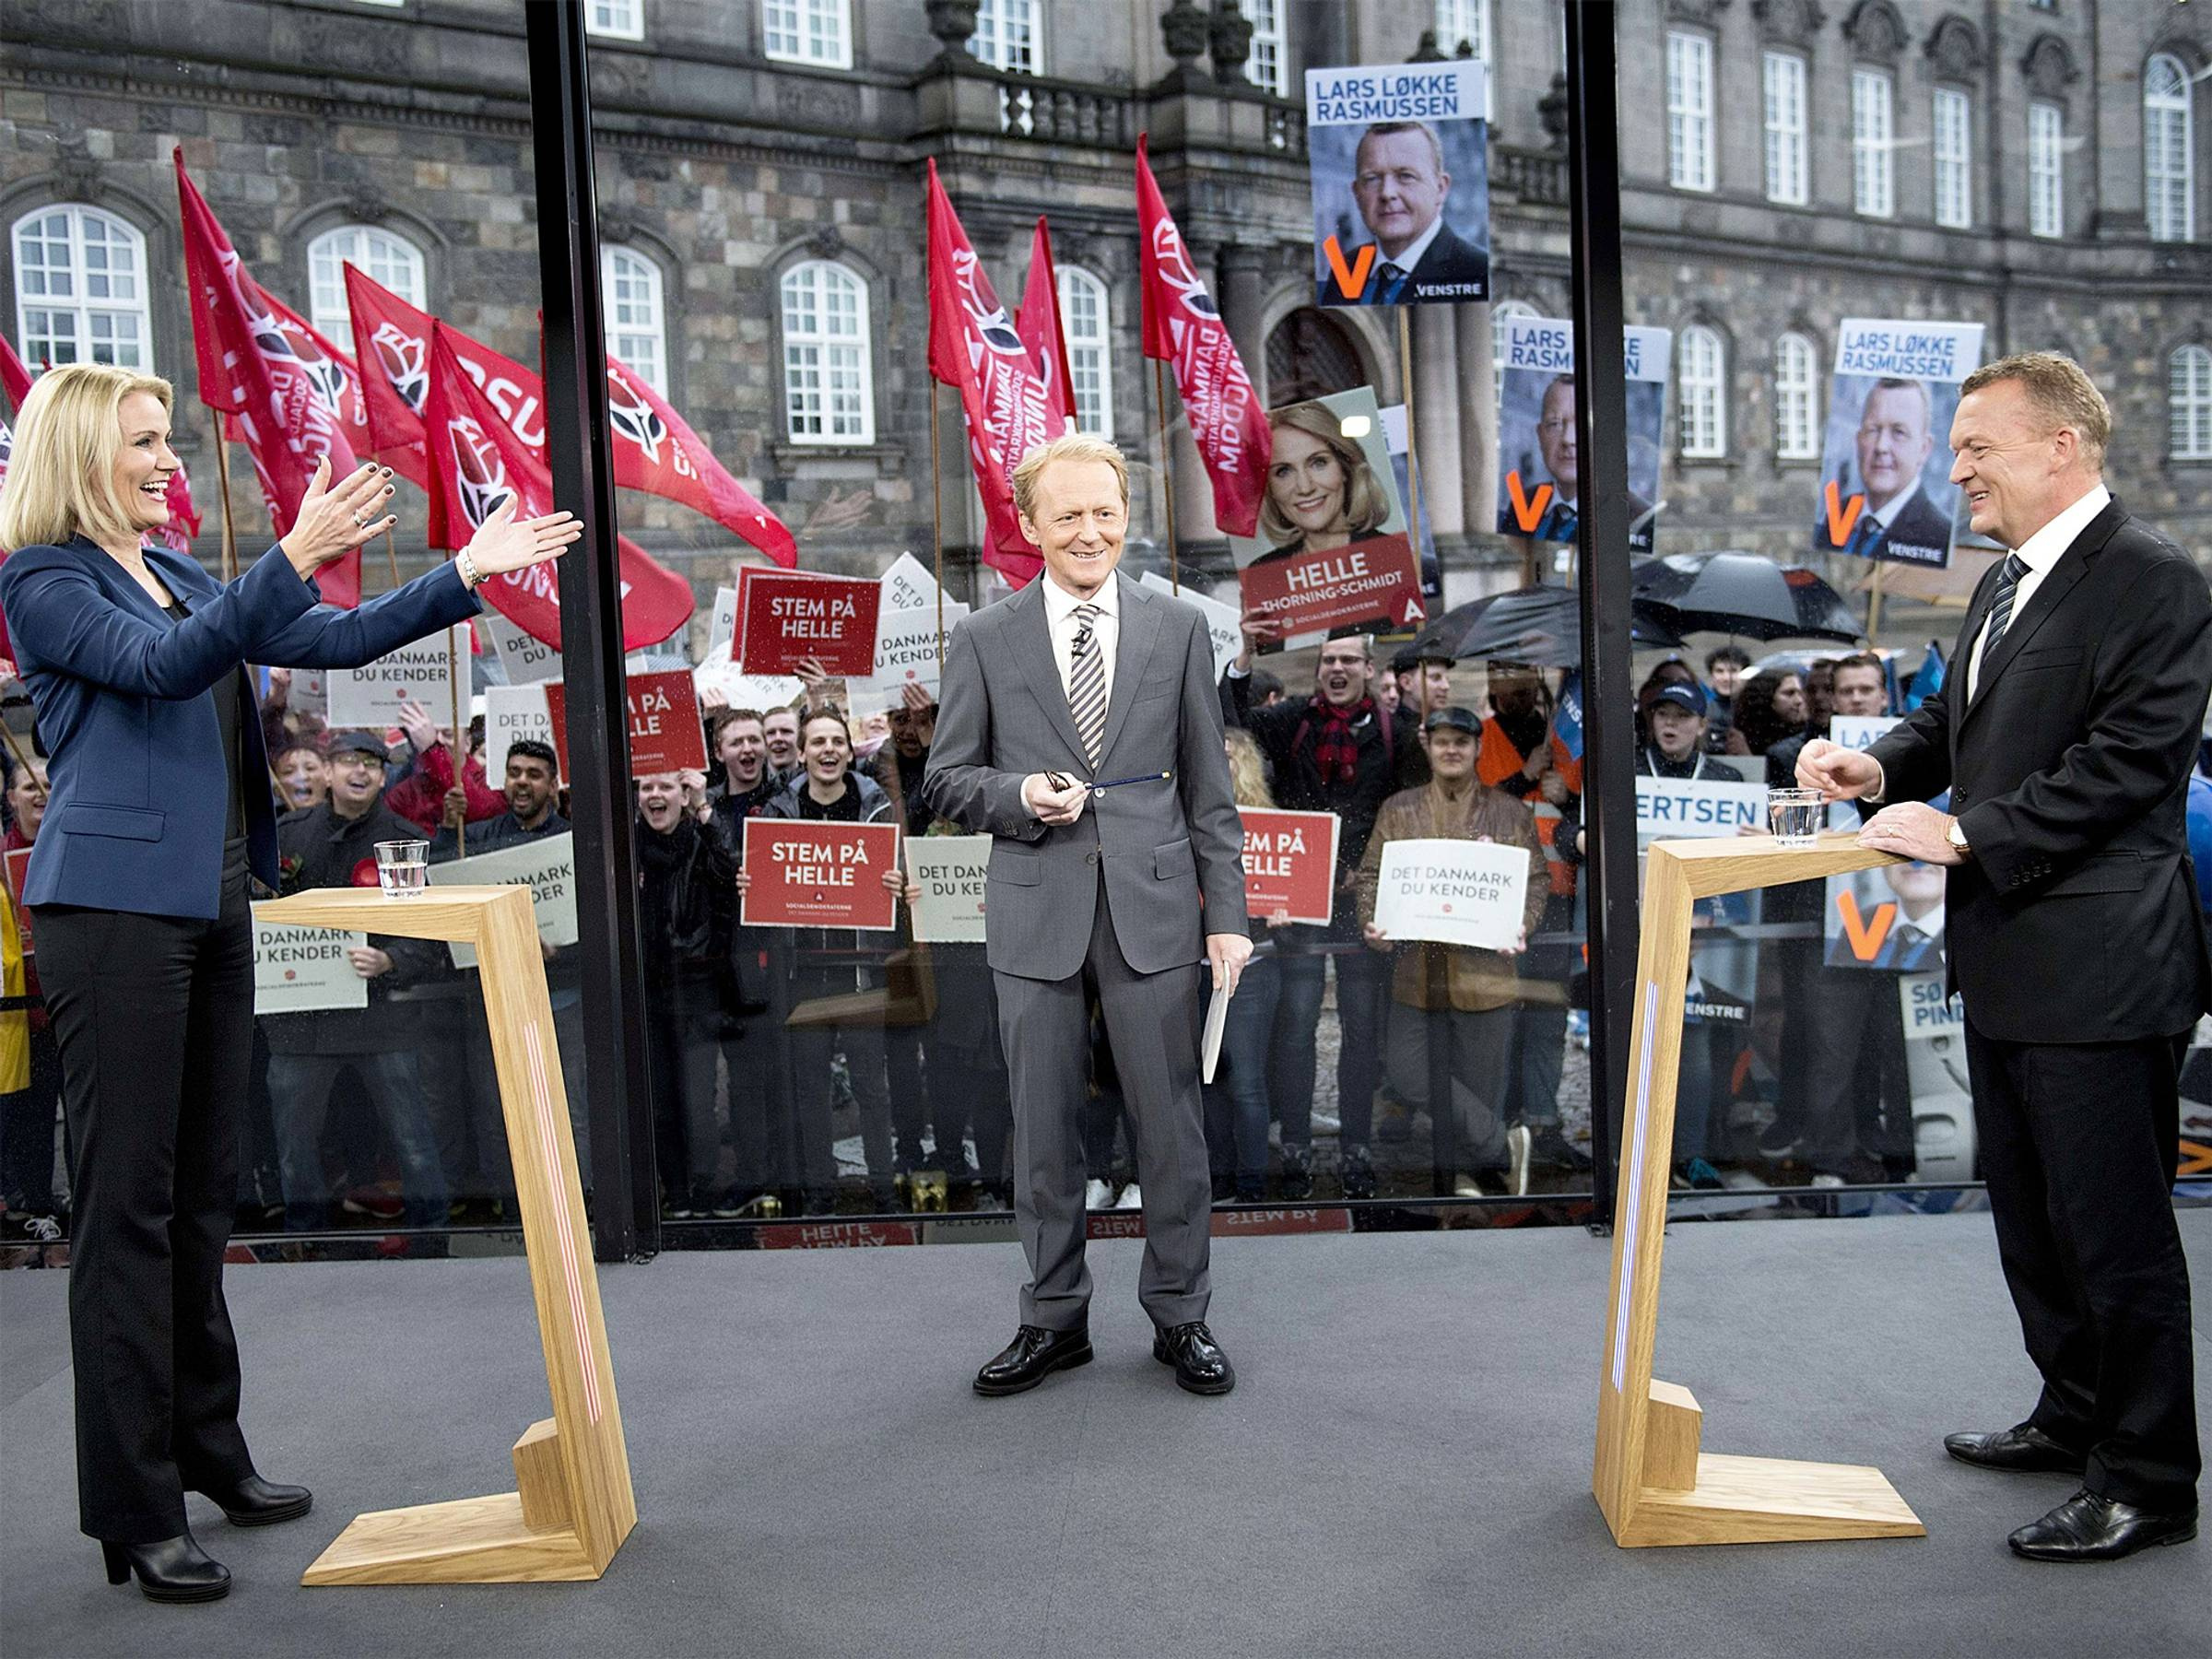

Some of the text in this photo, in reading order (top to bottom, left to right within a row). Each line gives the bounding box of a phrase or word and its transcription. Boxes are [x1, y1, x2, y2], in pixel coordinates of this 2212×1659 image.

[1316, 75, 1458, 100] LARS LØKKE
[1317, 97, 1458, 121] RASMUSSEN
[1322, 234, 1376, 300] V
[1415, 284, 1481, 297] VENSTRE
[1512, 327, 1565, 349] LARS
[1845, 332, 1956, 357] LARS LØKKE
[1843, 352, 1954, 377] RASMUSSEN
[1505, 470, 1553, 532] V
[1824, 479, 1865, 547] V
[1286, 552, 1370, 591] HELLE
[893, 575, 915, 597] DET
[1261, 571, 1403, 612] THORNING-SCHMIDT
[771, 594, 855, 618] STEM PÅ
[1404, 598, 1426, 622] A
[782, 620, 843, 639] HELLE
[882, 630, 951, 651] DANMAR
[507, 636, 536, 653] DET
[376, 652, 458, 665] DANMAR
[524, 647, 546, 665] DU
[353, 668, 448, 681] DU KENDER
[641, 686, 672, 712] PÅ
[499, 713, 527, 727] DET
[1637, 794, 1757, 825] ERTSEN
[771, 839, 869, 865] STEM PÅ
[1242, 828, 1306, 855] EM PÅ
[785, 866, 854, 887] HELLE
[919, 865, 948, 878] DET
[1241, 854, 1292, 877] ELLE
[1392, 867, 1512, 888] DET DANMARK
[933, 883, 956, 896] DU
[1401, 882, 1500, 902] DU KENDER
[1836, 888, 1897, 961] V
[260, 928, 354, 945] DANMARK
[268, 945, 342, 963] KENDER
[1685, 1002, 1745, 1019] ENSTRE
